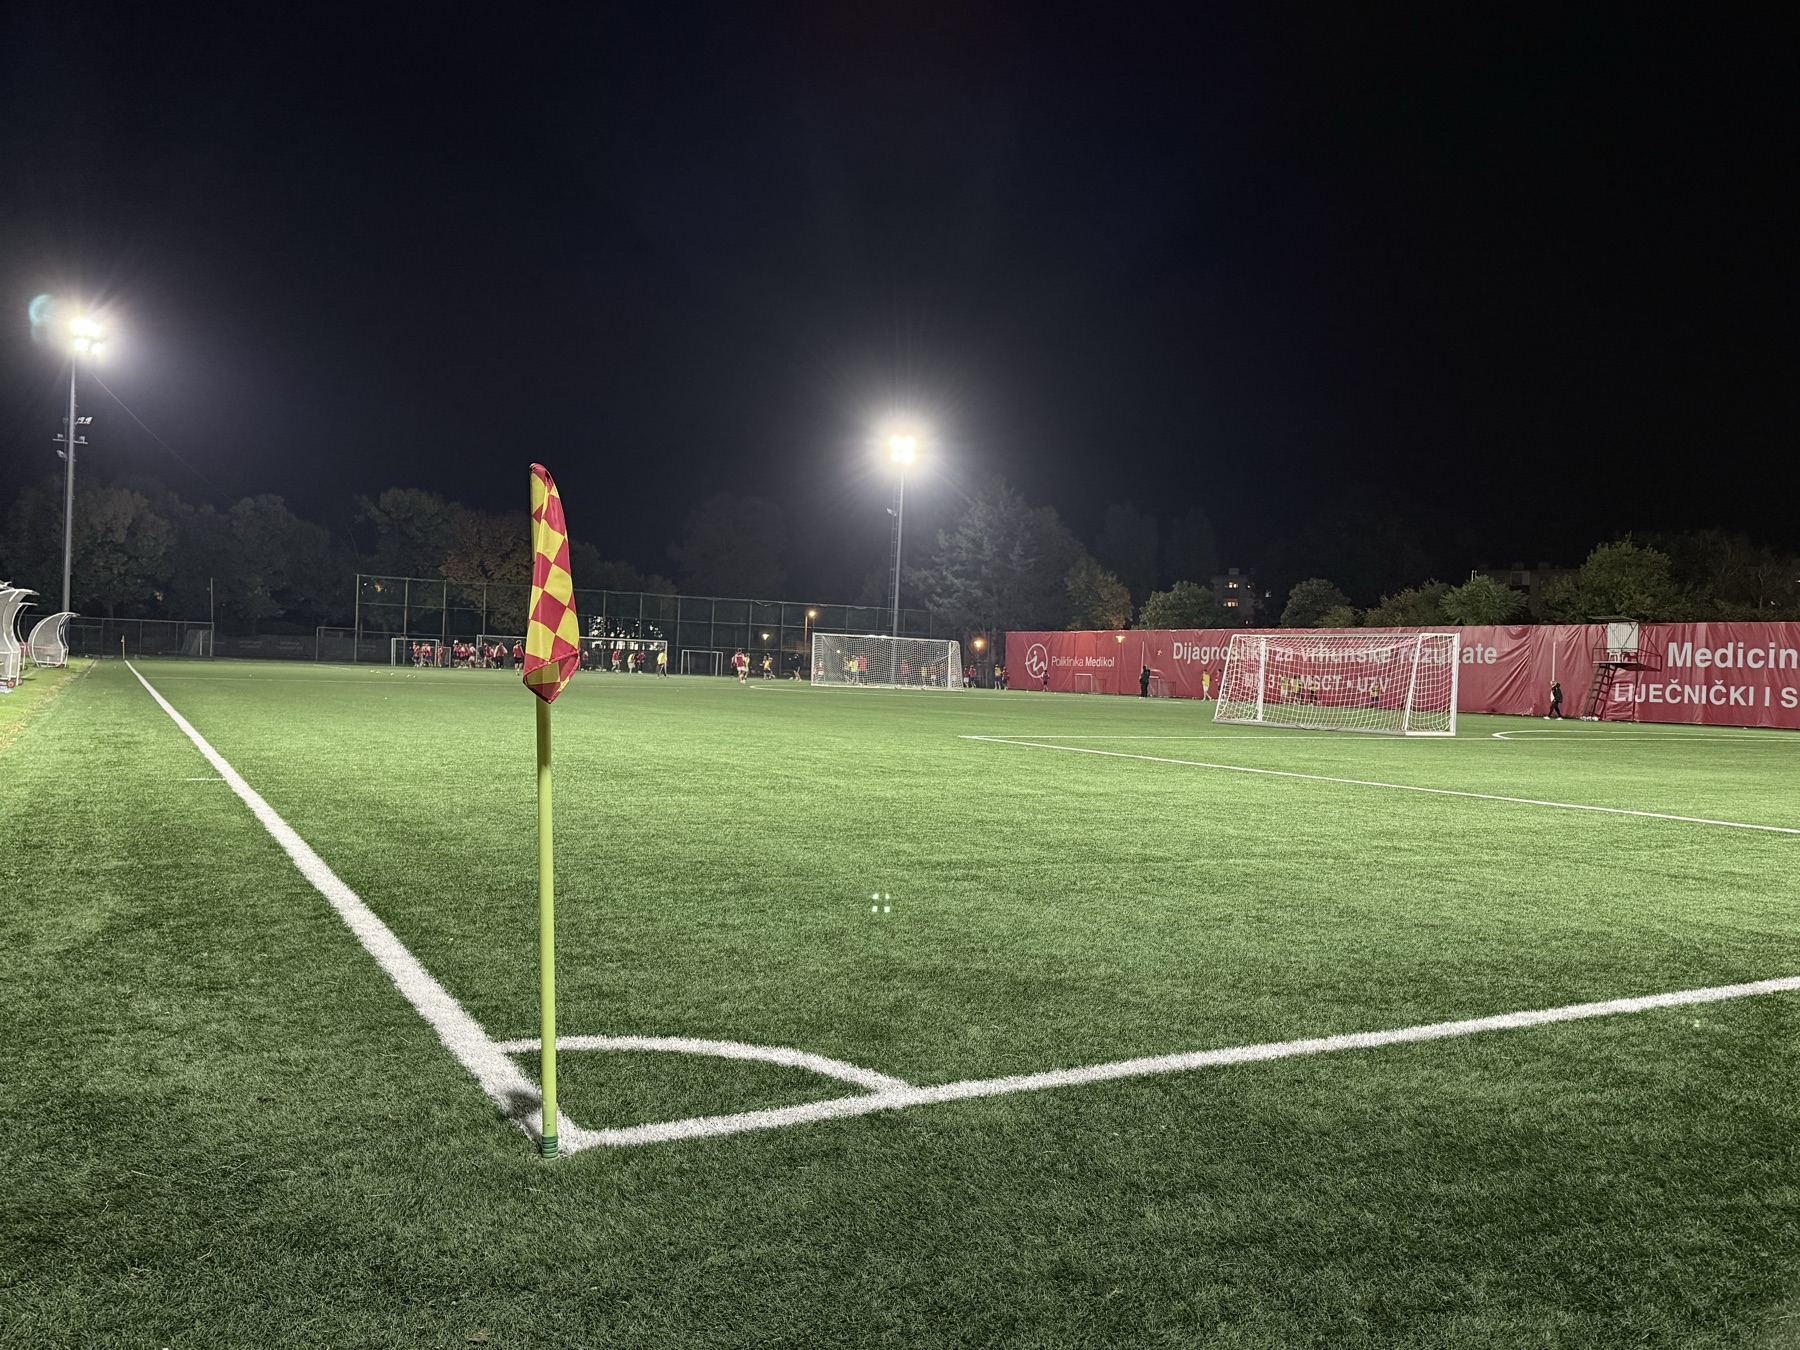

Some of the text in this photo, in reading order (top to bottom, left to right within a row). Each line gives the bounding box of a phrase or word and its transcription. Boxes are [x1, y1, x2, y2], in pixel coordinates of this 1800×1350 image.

[1051, 655, 1115, 668] Poliklinika Medikol
[1667, 641, 1798, 669] Medicin
[1614, 678, 1754, 706] LIJEČNIČKI
[1764, 686, 1771, 707] I
